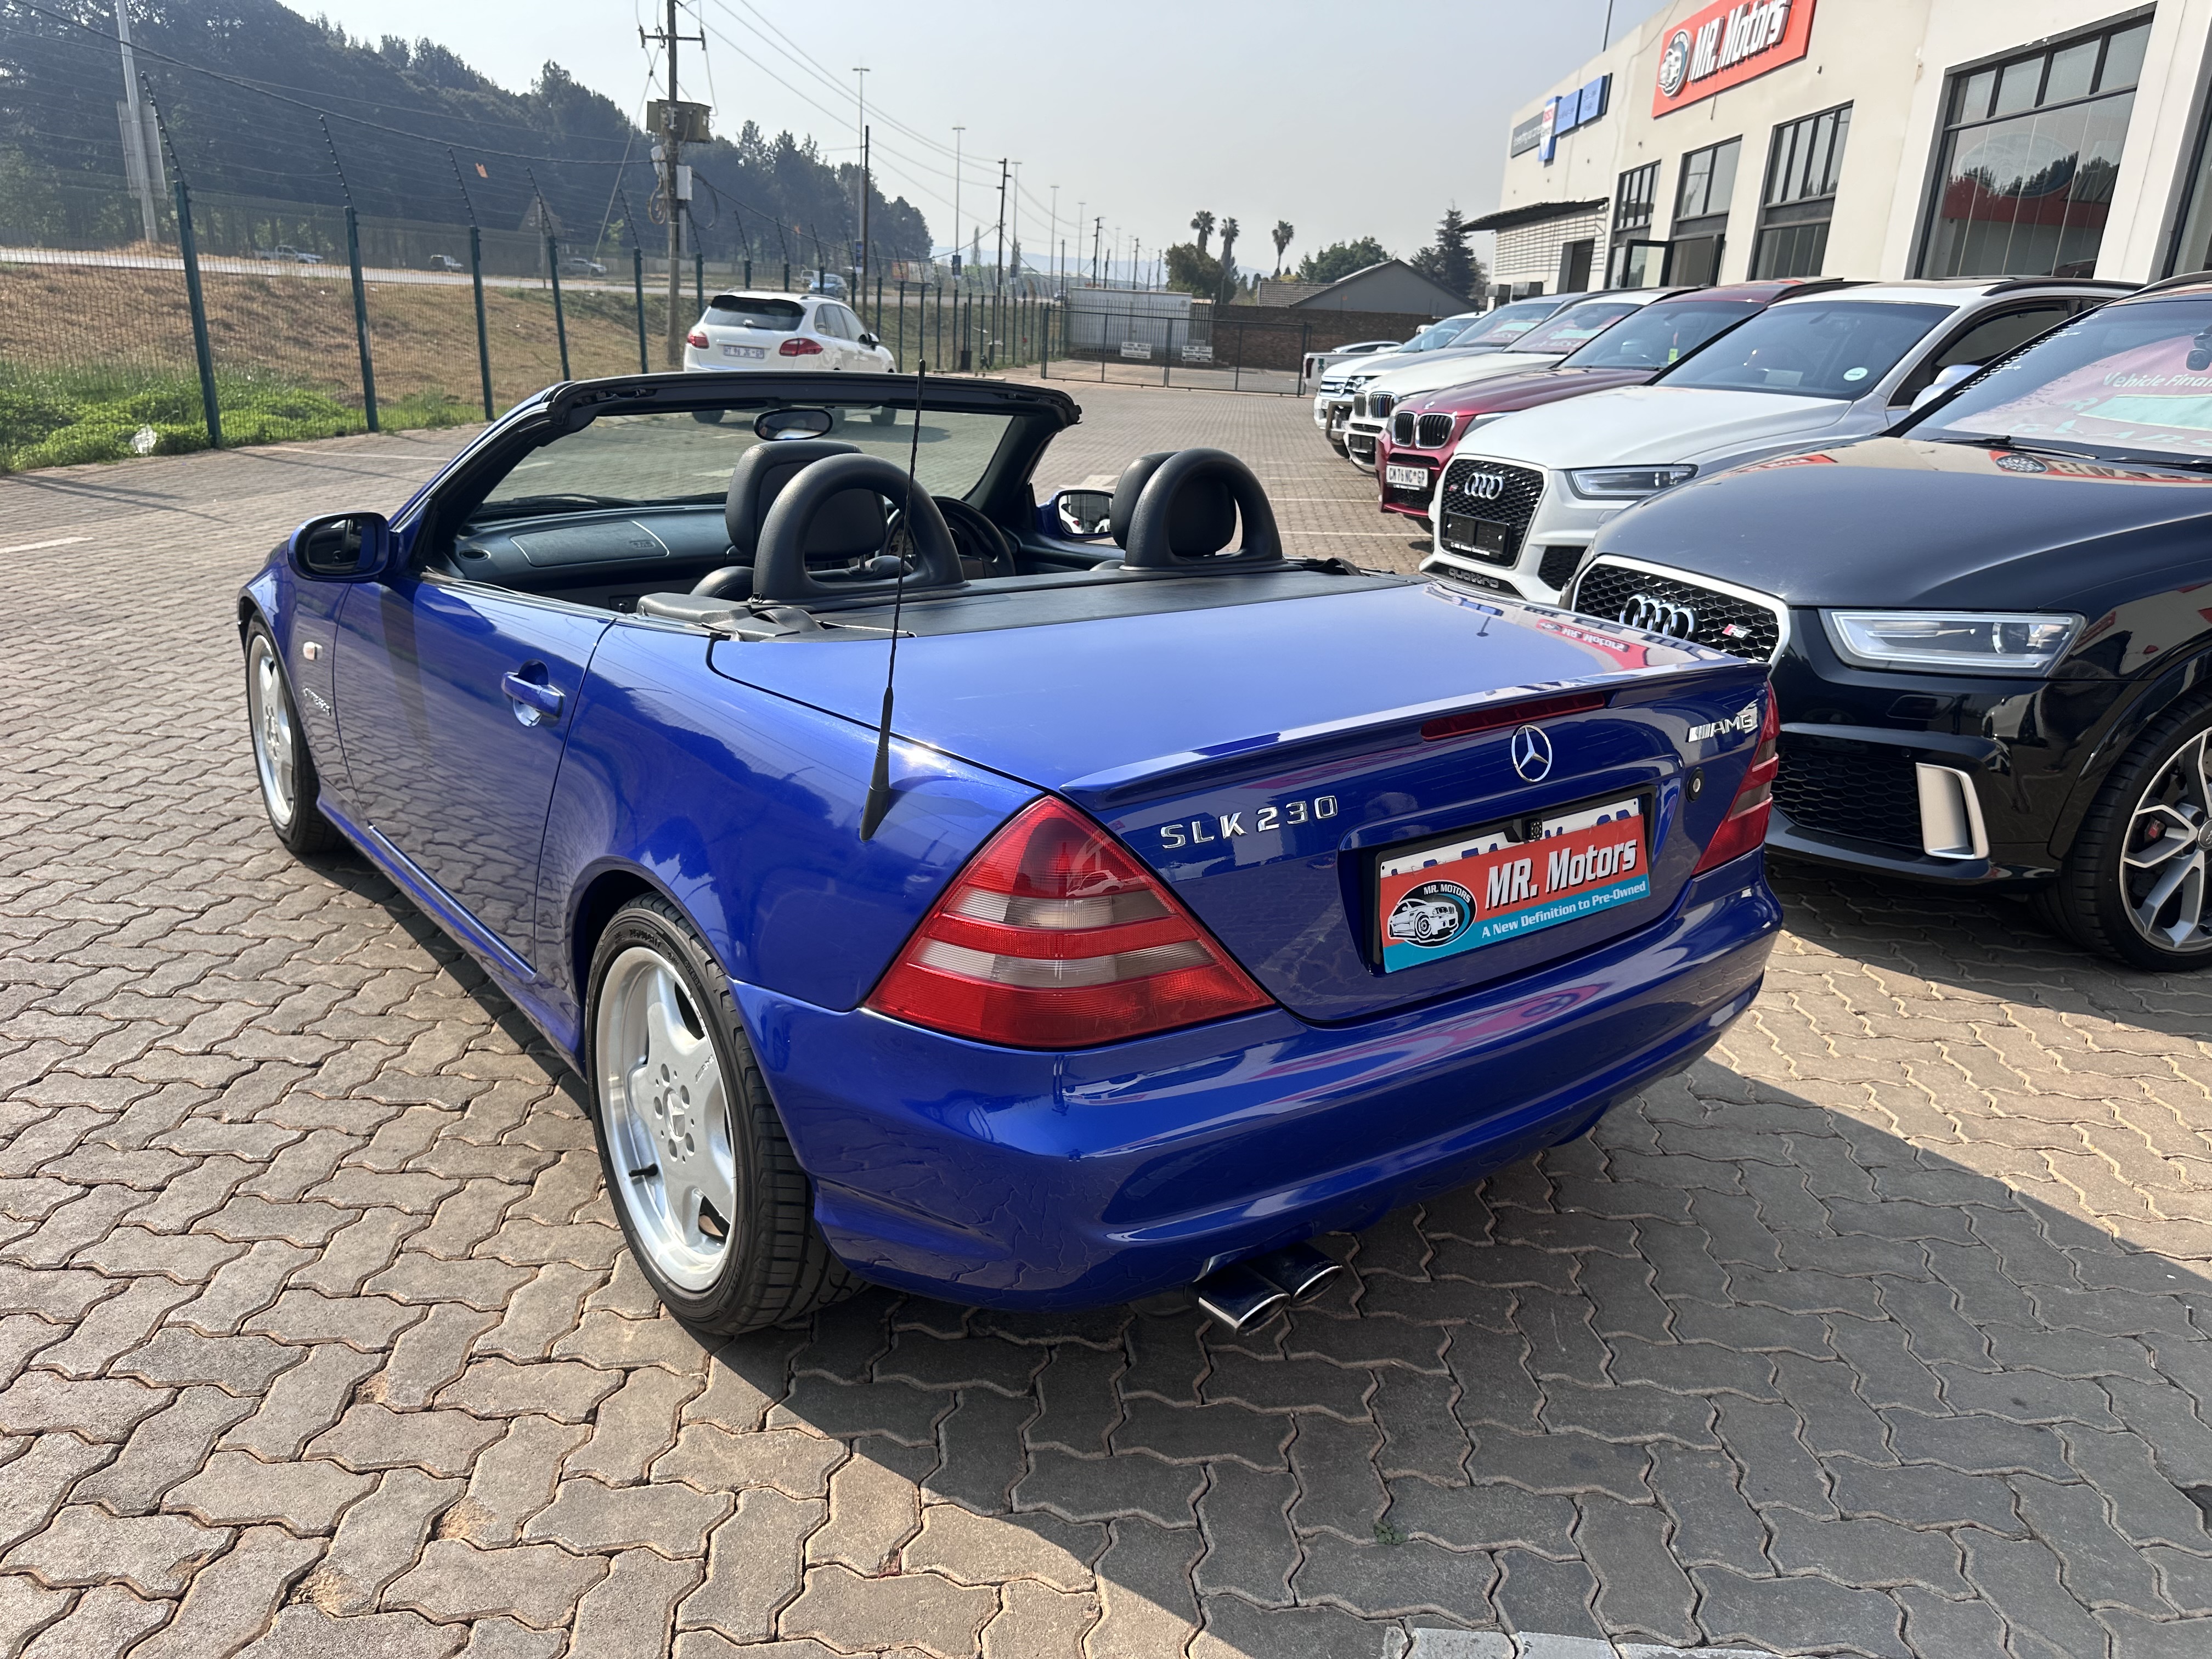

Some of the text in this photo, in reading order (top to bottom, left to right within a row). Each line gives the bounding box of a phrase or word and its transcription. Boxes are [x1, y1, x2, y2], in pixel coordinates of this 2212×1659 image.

[1687, 0, 1790, 82] MR. Motors
[2103, 372, 2166, 387] Vehicle
[1448, 568, 1499, 589] quattro
[1709, 714, 1753, 738] AMG
[1160, 795, 1338, 849] SLK 230
[1423, 884, 1471, 904] MR. MOTORS
[1485, 839, 1637, 910] MR. Motors
[1482, 880, 1646, 939] A New Definition to Pre-Owned
